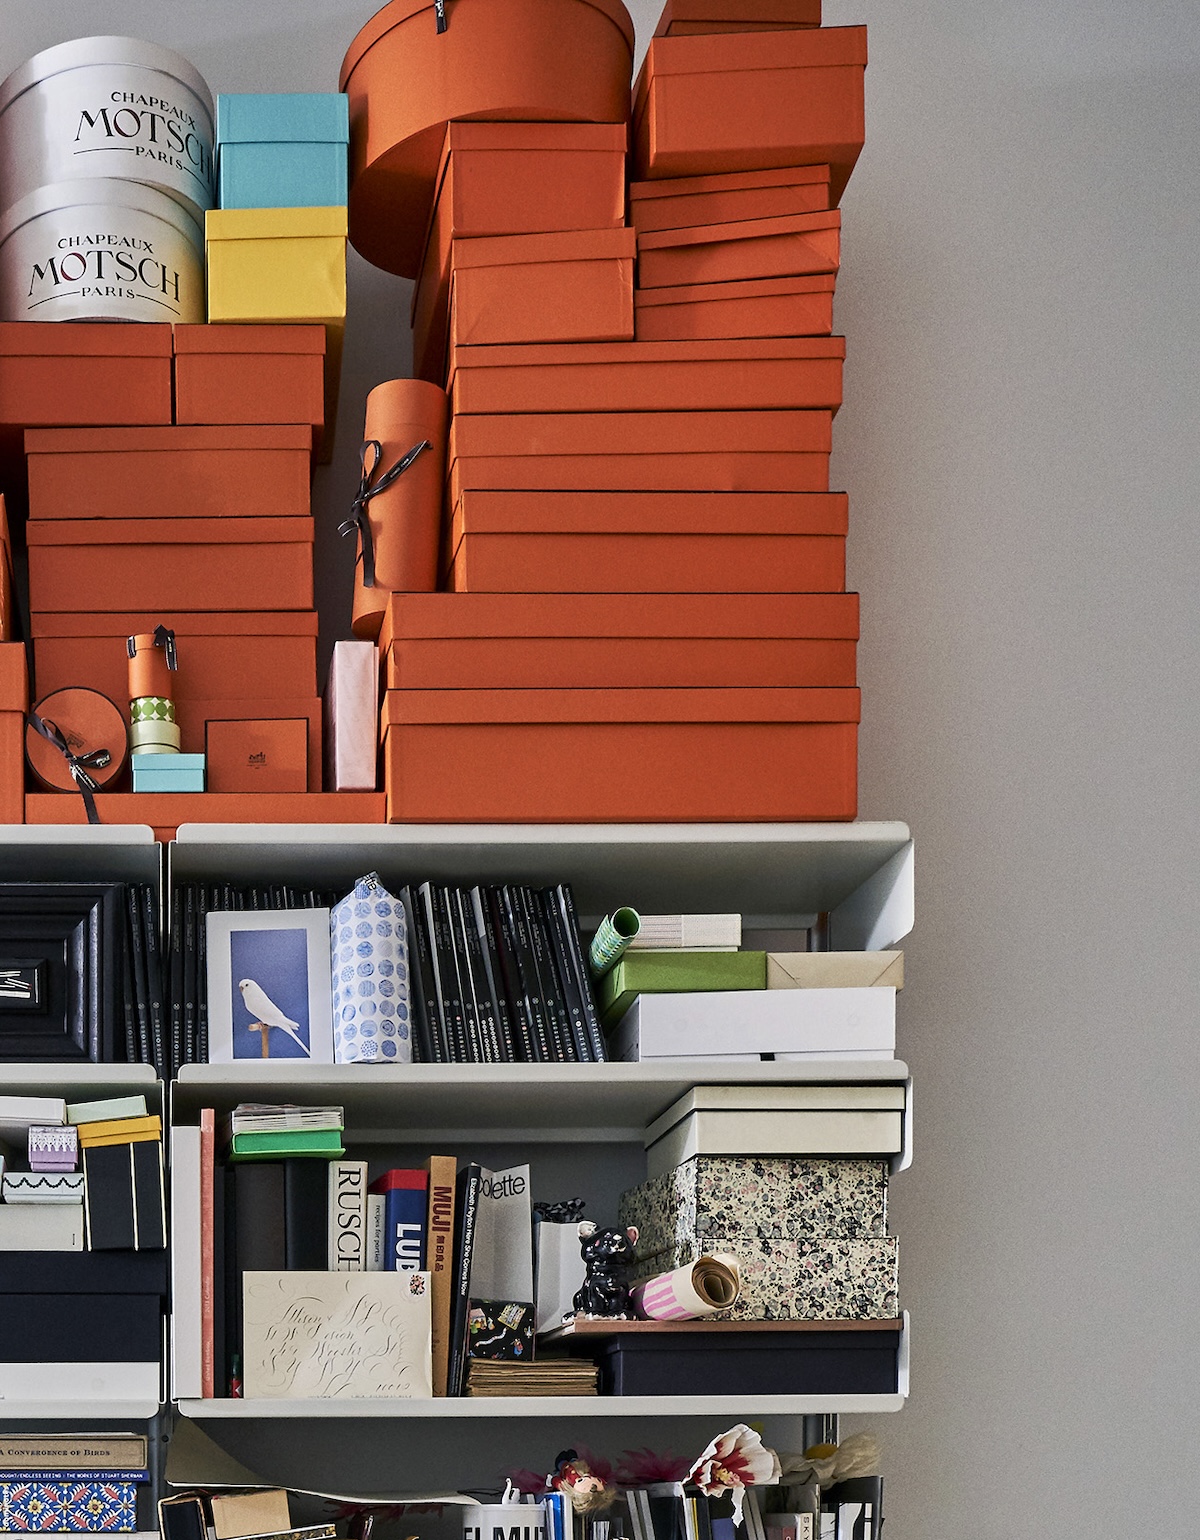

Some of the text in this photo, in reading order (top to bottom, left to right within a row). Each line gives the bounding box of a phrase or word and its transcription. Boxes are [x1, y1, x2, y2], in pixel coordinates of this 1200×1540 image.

[111, 91, 196, 131] CHAPEAUX
[74, 108, 210, 183] MOTSCH
[136, 146, 183, 170] PARIS
[57, 234, 154, 253] CHAPEAUX
[28, 250, 180, 303] MOTSCH
[81, 286, 135, 299] PARIS
[432, 1186, 452, 1231] MUJI
[434, 1235, 446, 1272] 無印良品
[460, 1178, 478, 1296] Elizabeth Peyton Here She Comes Now
